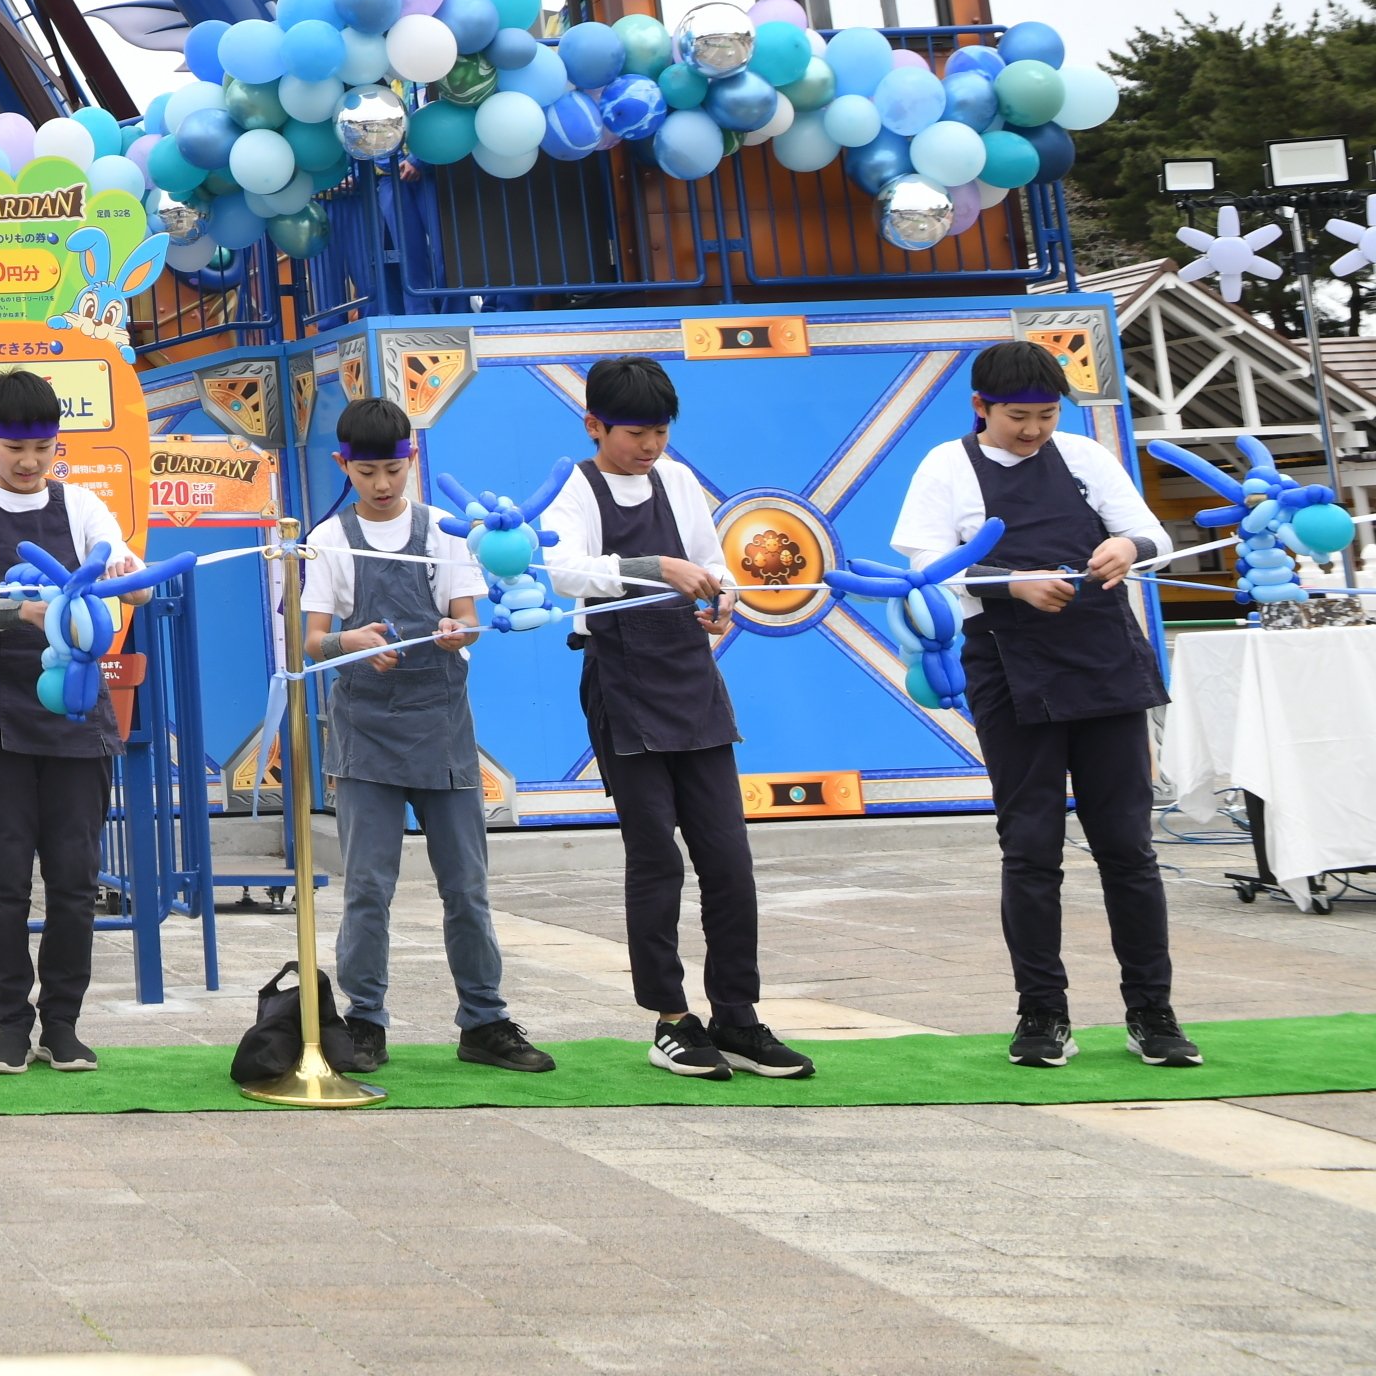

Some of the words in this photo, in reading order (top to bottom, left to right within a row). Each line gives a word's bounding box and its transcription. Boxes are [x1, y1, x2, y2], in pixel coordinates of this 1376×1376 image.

[150, 452, 253, 481] GUARDIAN
[150, 480, 190, 506] 120
[192, 492, 213, 505] cm
[192, 483, 215, 491] センチ
